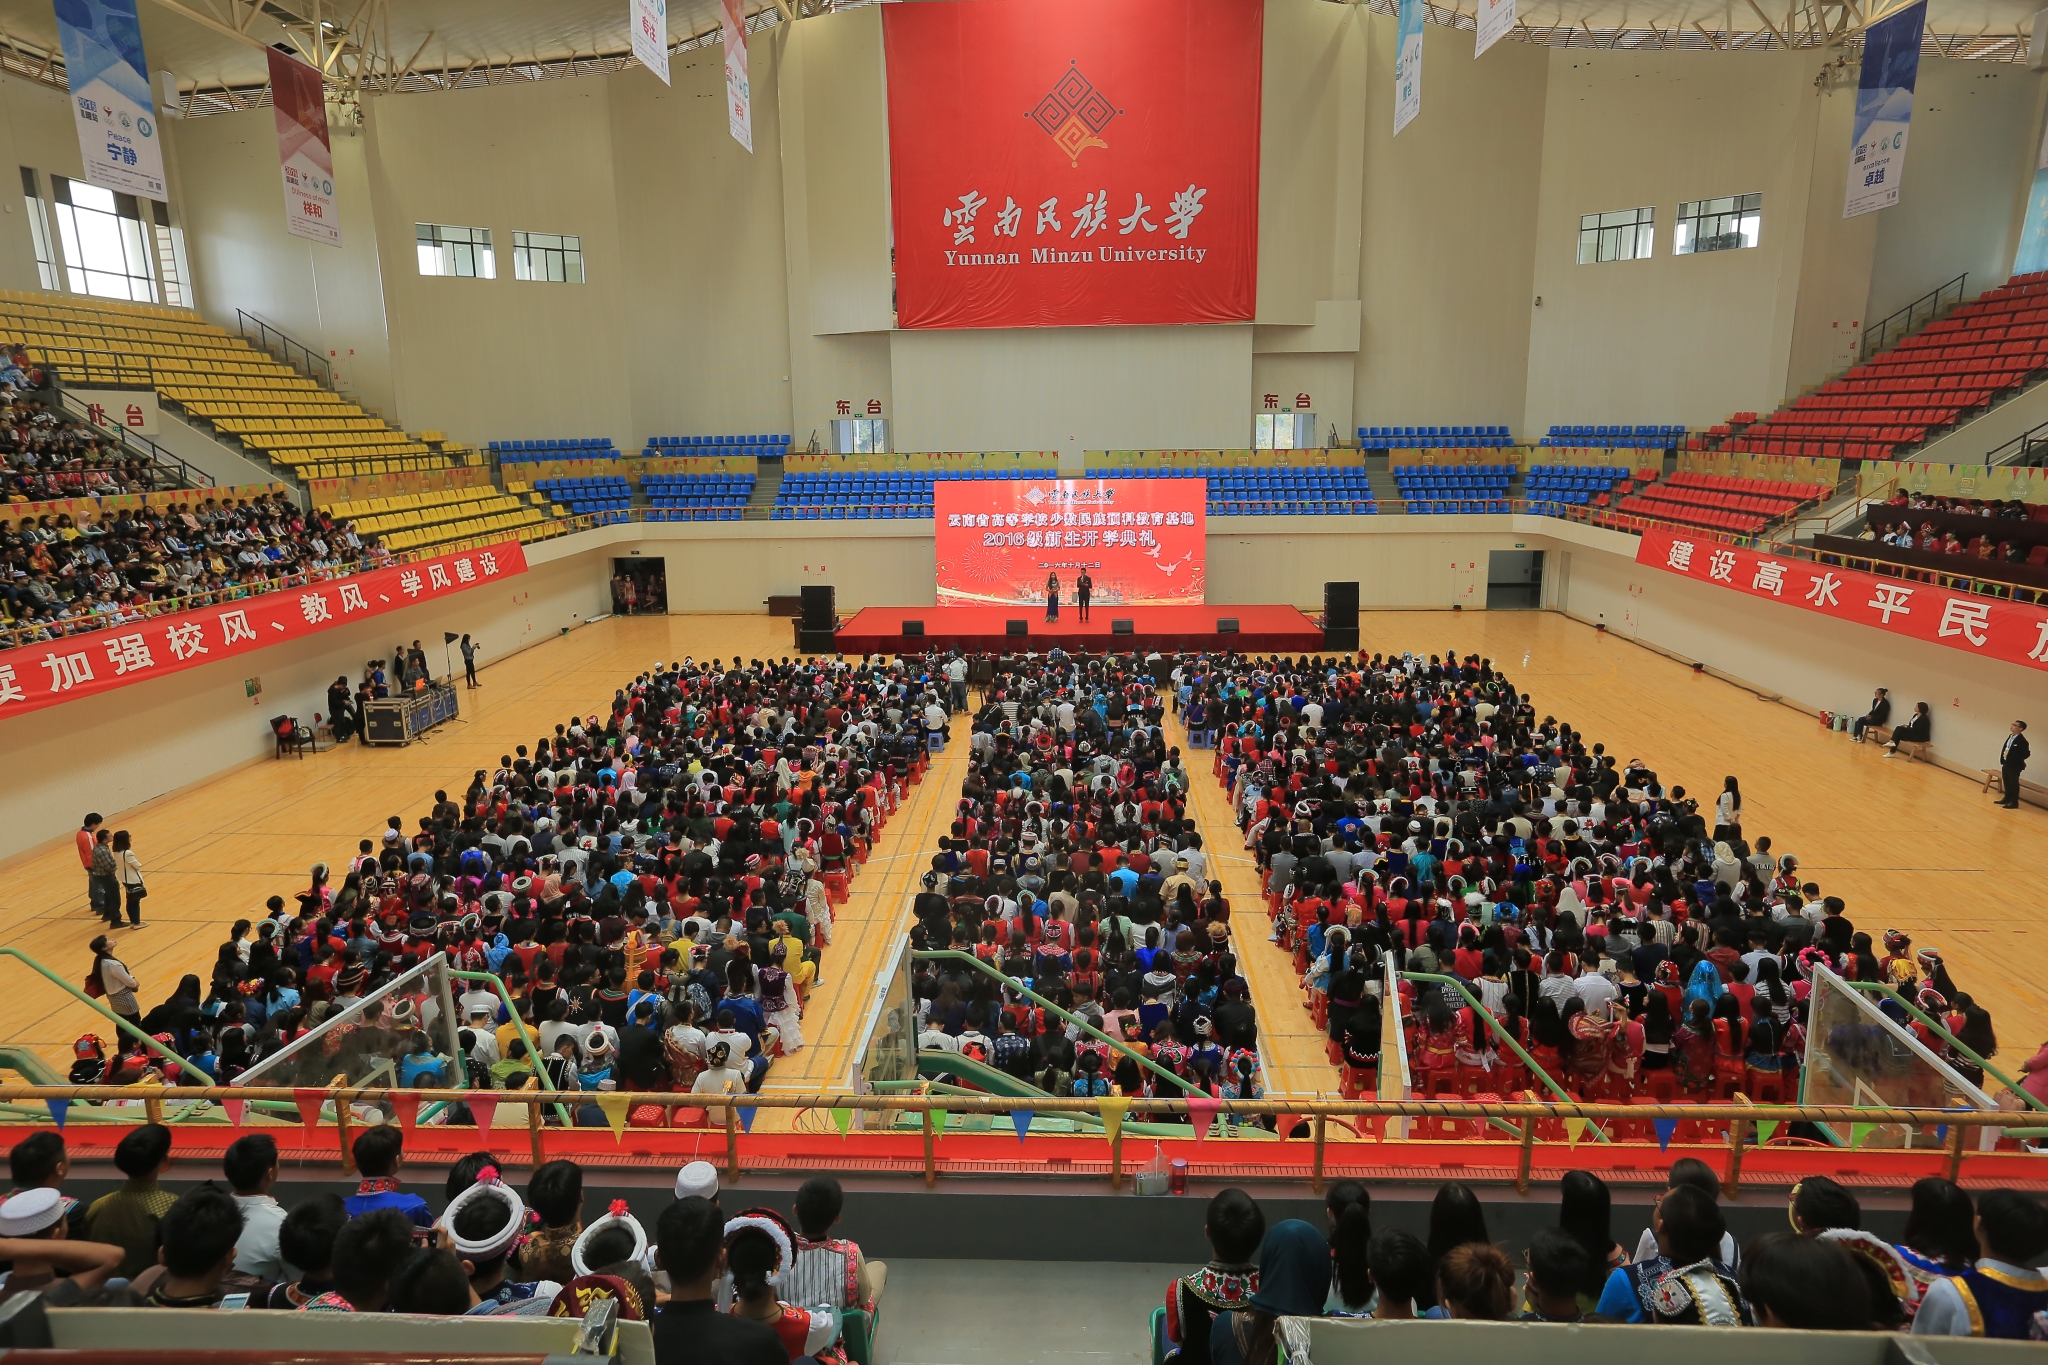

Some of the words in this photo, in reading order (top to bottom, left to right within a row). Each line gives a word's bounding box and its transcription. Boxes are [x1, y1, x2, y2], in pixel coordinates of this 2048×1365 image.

[107, 130, 132, 144] Peace
[107, 143, 138, 166] 宁静
[1864, 168, 1885, 187] 卓越
[303, 200, 323, 218] 祥和
[944, 249, 1020, 266] Yunnan
[1030, 247, 1093, 264] Minzu
[1098, 244, 1207, 264] University
[836, 399, 881, 414] 东台
[1263, 393, 1310, 408] 东台
[87, 403, 144, 427] 北台
[983, 529, 1156, 547] 2016级新生开学典礼
